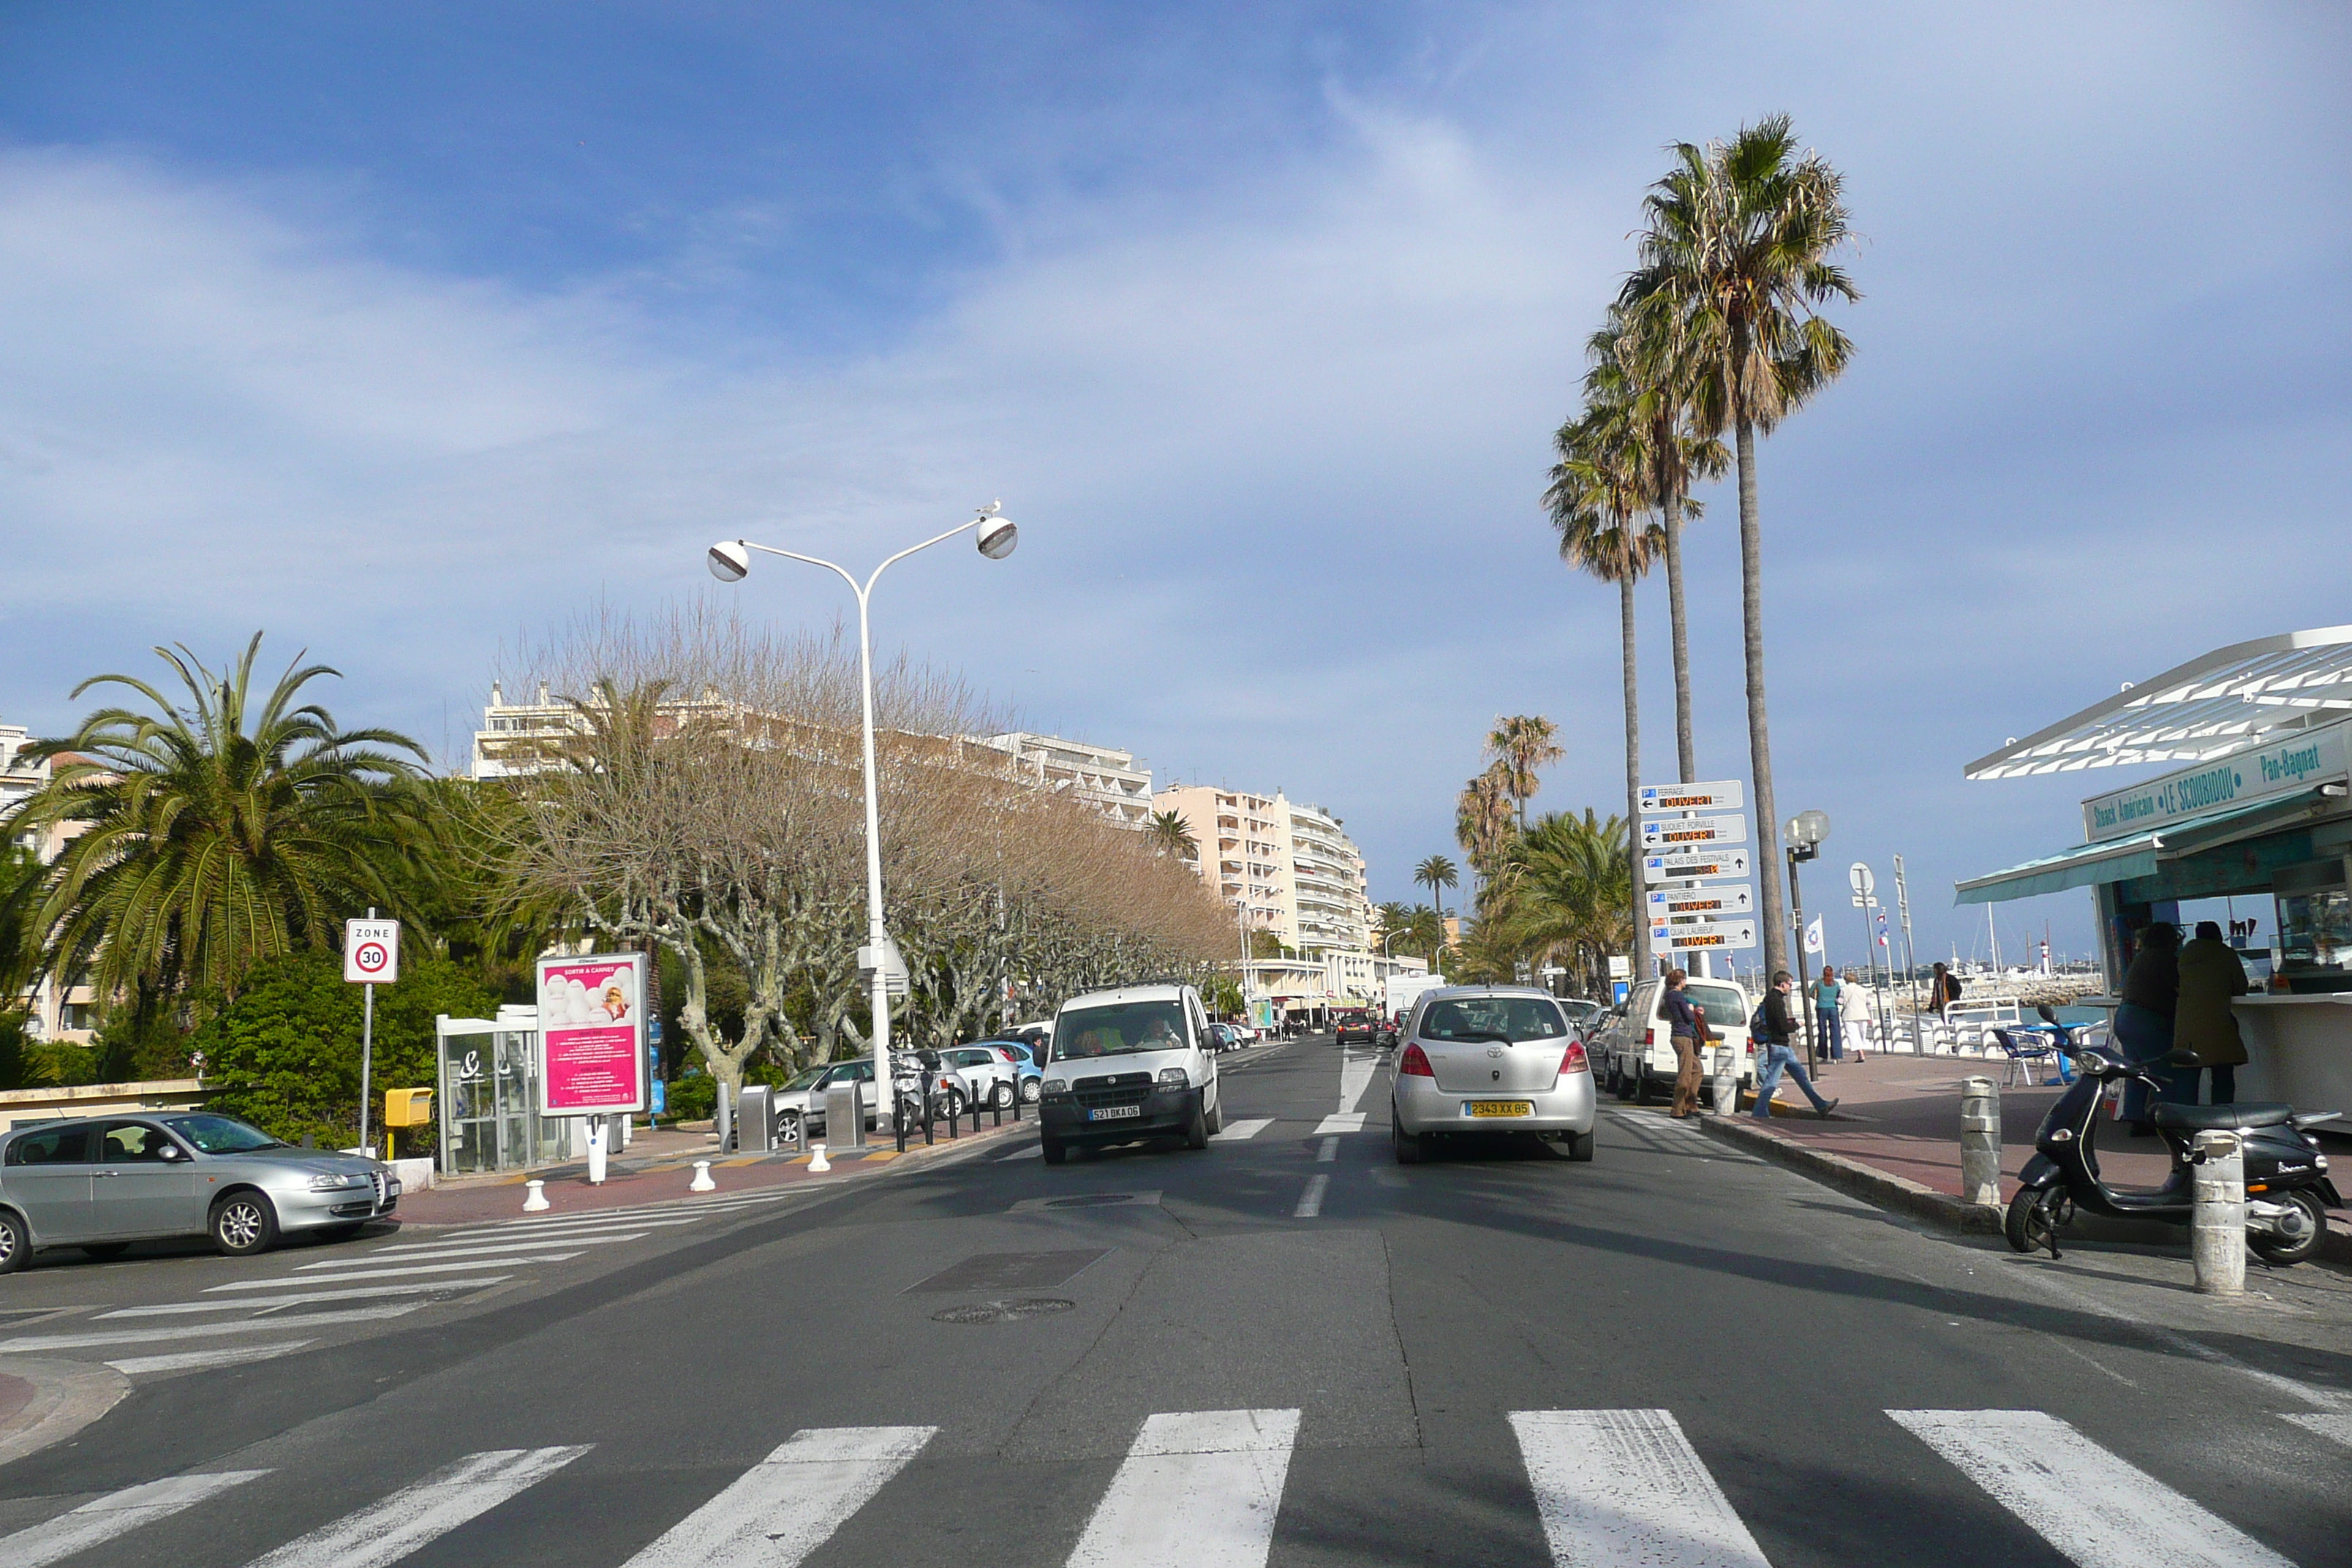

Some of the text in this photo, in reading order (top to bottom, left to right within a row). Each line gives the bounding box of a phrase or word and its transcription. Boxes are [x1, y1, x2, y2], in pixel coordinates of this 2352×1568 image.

[2094, 743, 2321, 828] Steack Américain LE SCOUBIDOU Pan-Bagnat
[1657, 787, 1685, 797] FERRAGE
[1666, 796, 1711, 807] OUVERT
[1661, 822, 1685, 832] SUQUET
[1687, 820, 1715, 829] FORVILLE
[1670, 829, 1715, 842] OUVERT
[1664, 856, 1684, 866] PALAIS
[1686, 856, 1698, 864] DES
[1700, 853, 1730, 863] FESTIVALS
[1667, 892, 1696, 900] PANTIERO
[1676, 900, 1719, 912] OUVERT
[356, 929, 389, 938] ZONE
[1655, 929, 1662, 937] P
[1670, 927, 1685, 936] QUAI
[1687, 926, 1715, 935] LAUBEUF
[363, 951, 380, 963] 30
[1094, 1107, 1139, 1119] 521 BKA 06
[1472, 1104, 1528, 1114] 2343 XX 85
